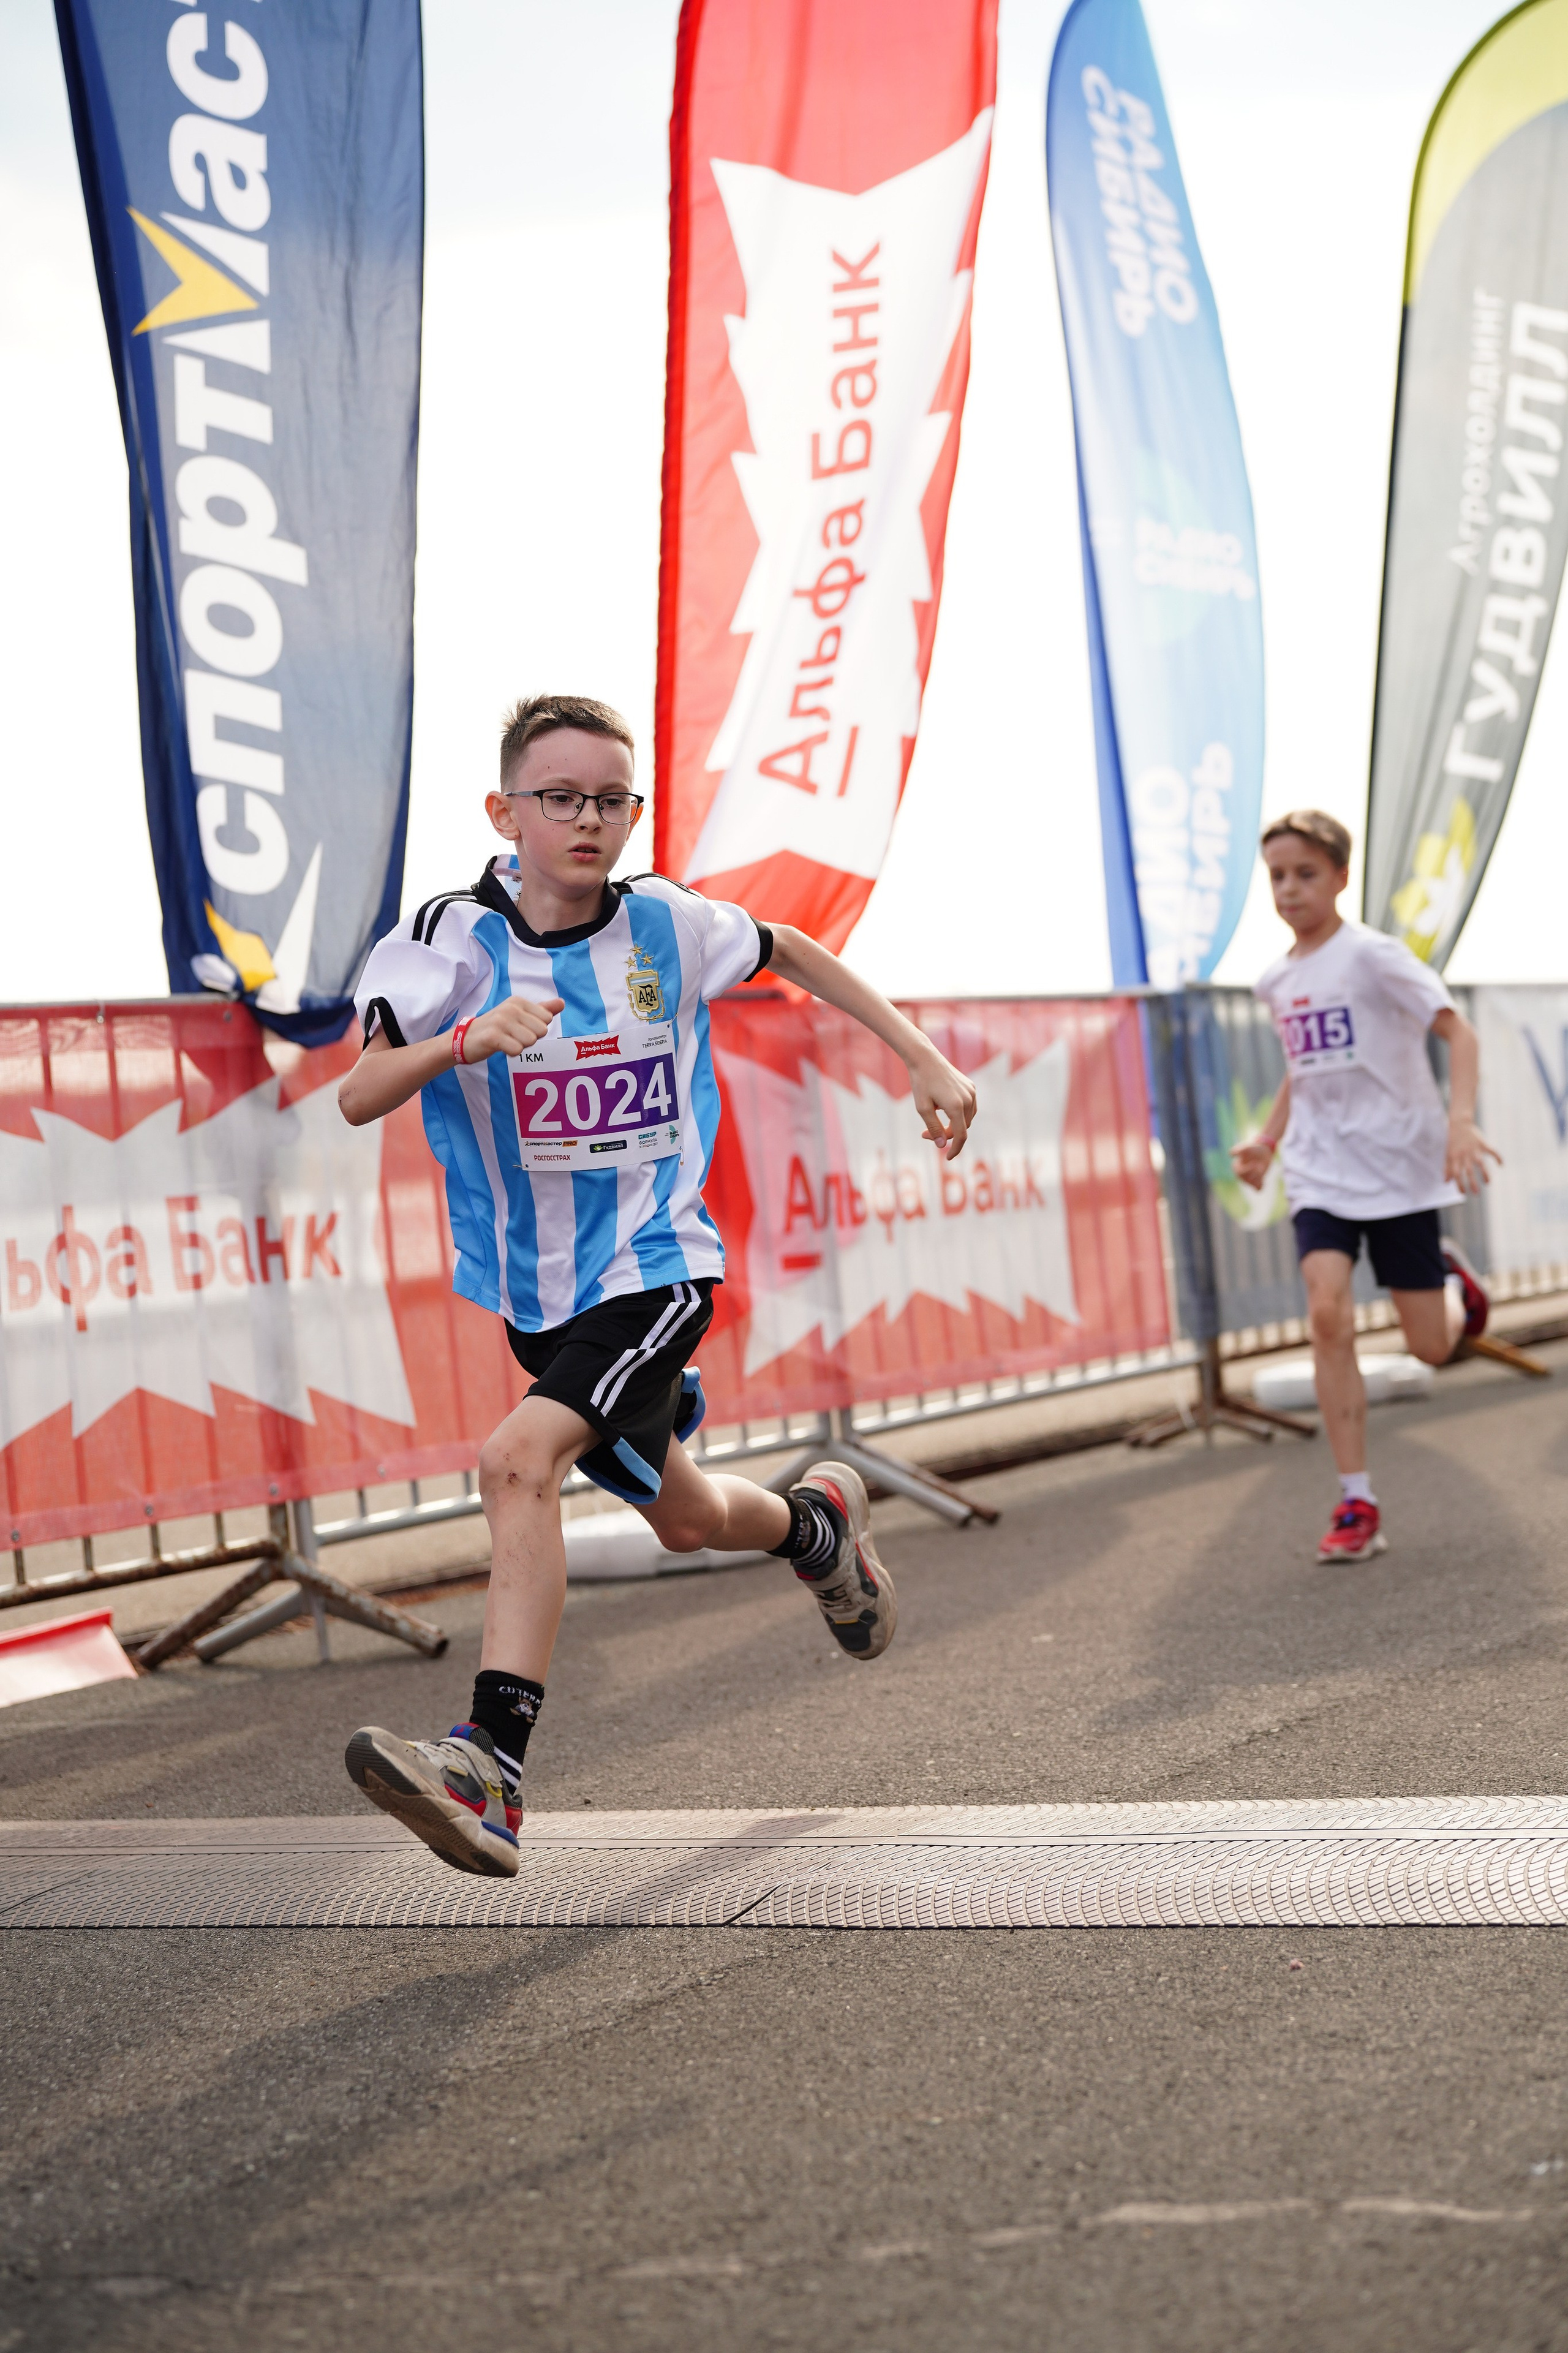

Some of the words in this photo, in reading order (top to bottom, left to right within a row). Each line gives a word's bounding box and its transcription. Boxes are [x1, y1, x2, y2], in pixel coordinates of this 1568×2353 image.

[1080, 64, 1158, 338] СИБИРЬ
[810, 241, 881, 481] Банк
[1443, 299, 1568, 784] ГУДВИЛЛ
[757, 497, 867, 798] Альфа
[1131, 764, 1191, 992] АДИО
[519, 1054, 522, 1063] 1
[524, 1062, 672, 1131] 2024
[581, 1044, 600, 1054] Альфа
[1281, 1011, 1349, 1052] 015
[165, 1195, 342, 1293] Банк
